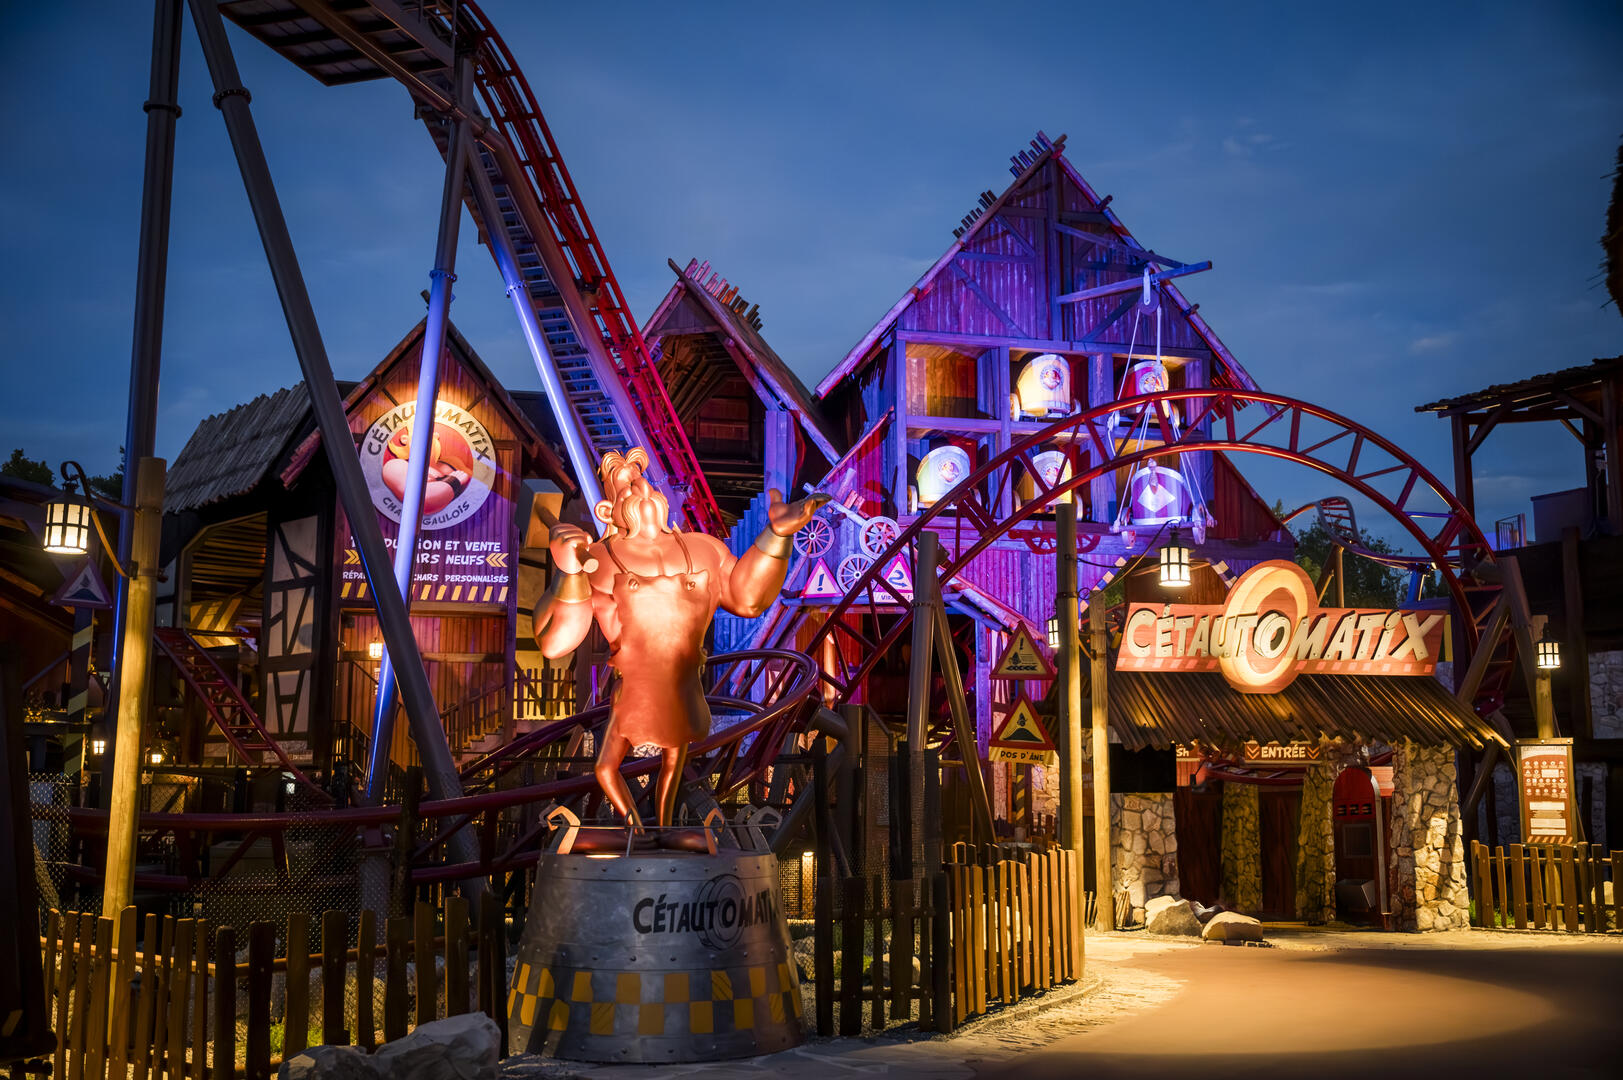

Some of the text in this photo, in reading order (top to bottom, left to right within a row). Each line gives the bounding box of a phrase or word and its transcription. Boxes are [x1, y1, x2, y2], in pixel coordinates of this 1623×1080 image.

[445, 540, 458, 551] ET
[464, 541, 501, 552] VENTE
[445, 554, 485, 566] NEUFS
[1261, 744, 1306, 759] ENTRÉE
